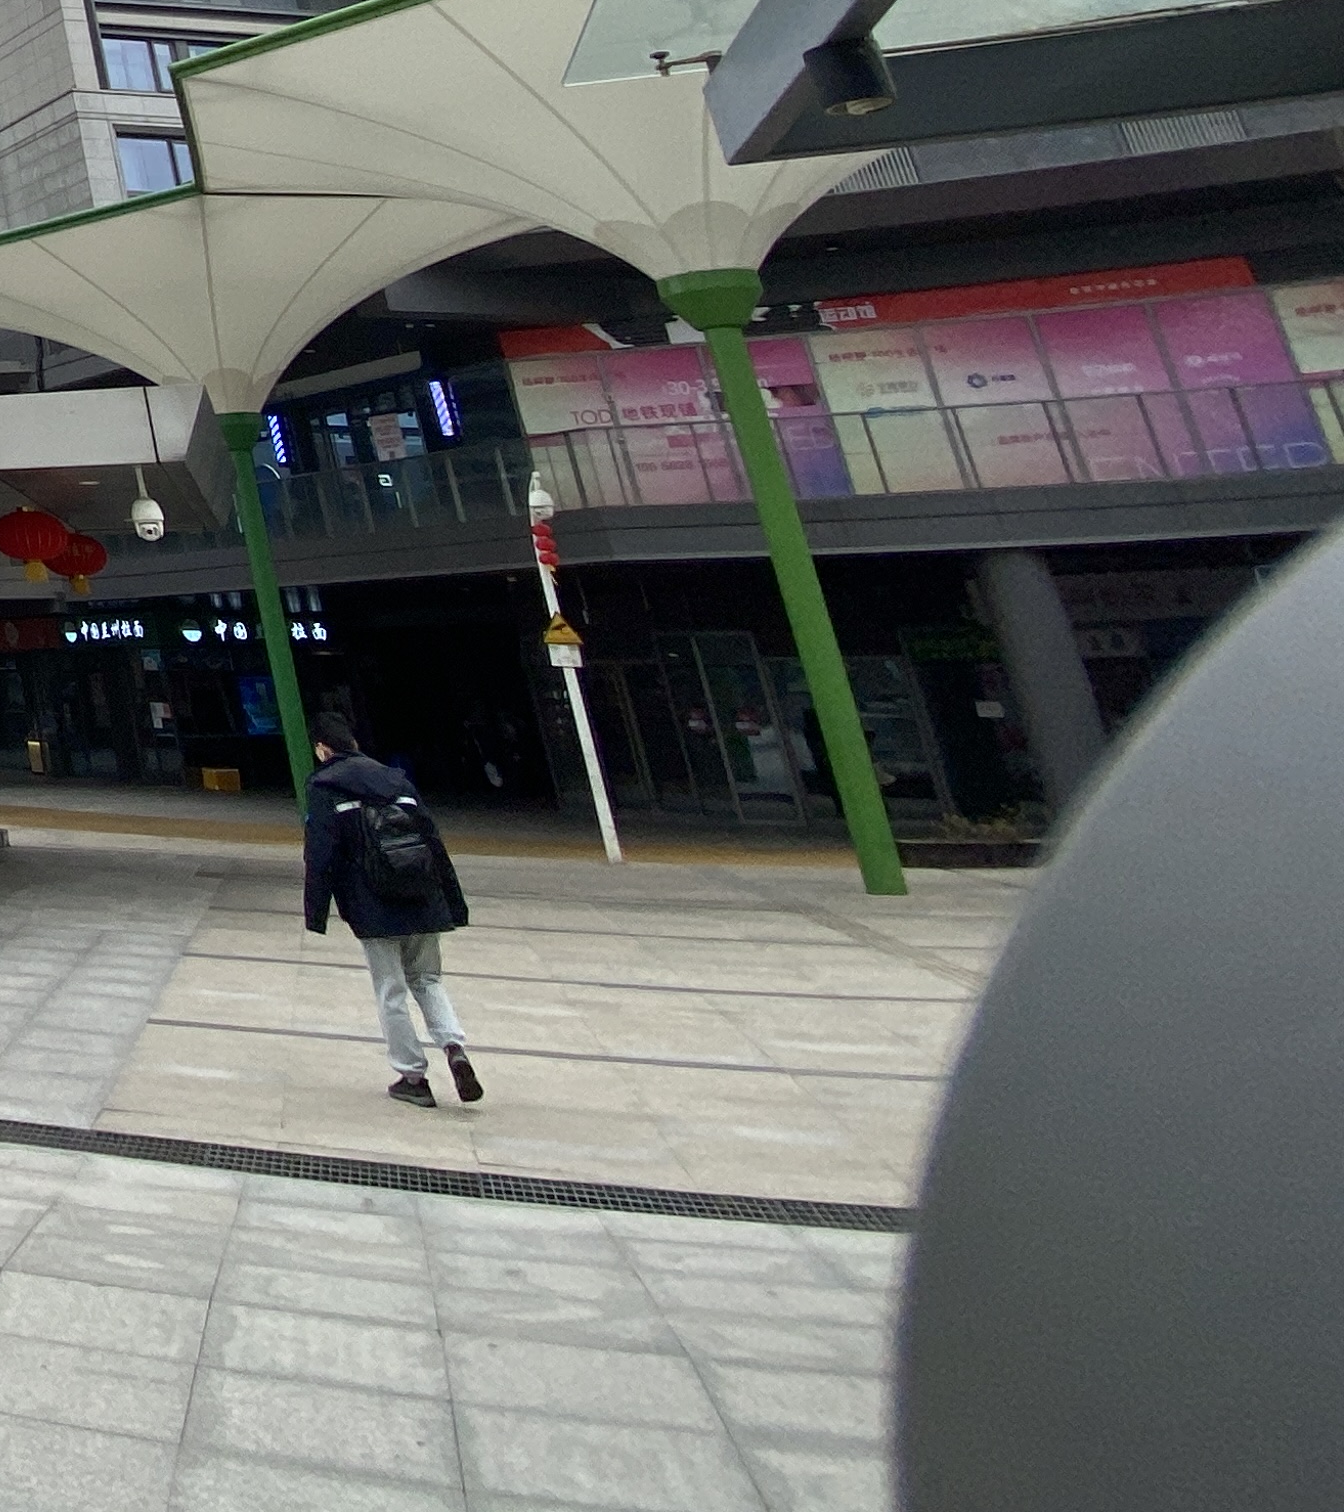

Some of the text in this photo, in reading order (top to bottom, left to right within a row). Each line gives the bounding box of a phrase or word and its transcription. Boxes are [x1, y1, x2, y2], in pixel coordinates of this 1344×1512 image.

[570, 409, 612, 426] TOD
[214, 619, 327, 643] 中国拉面
